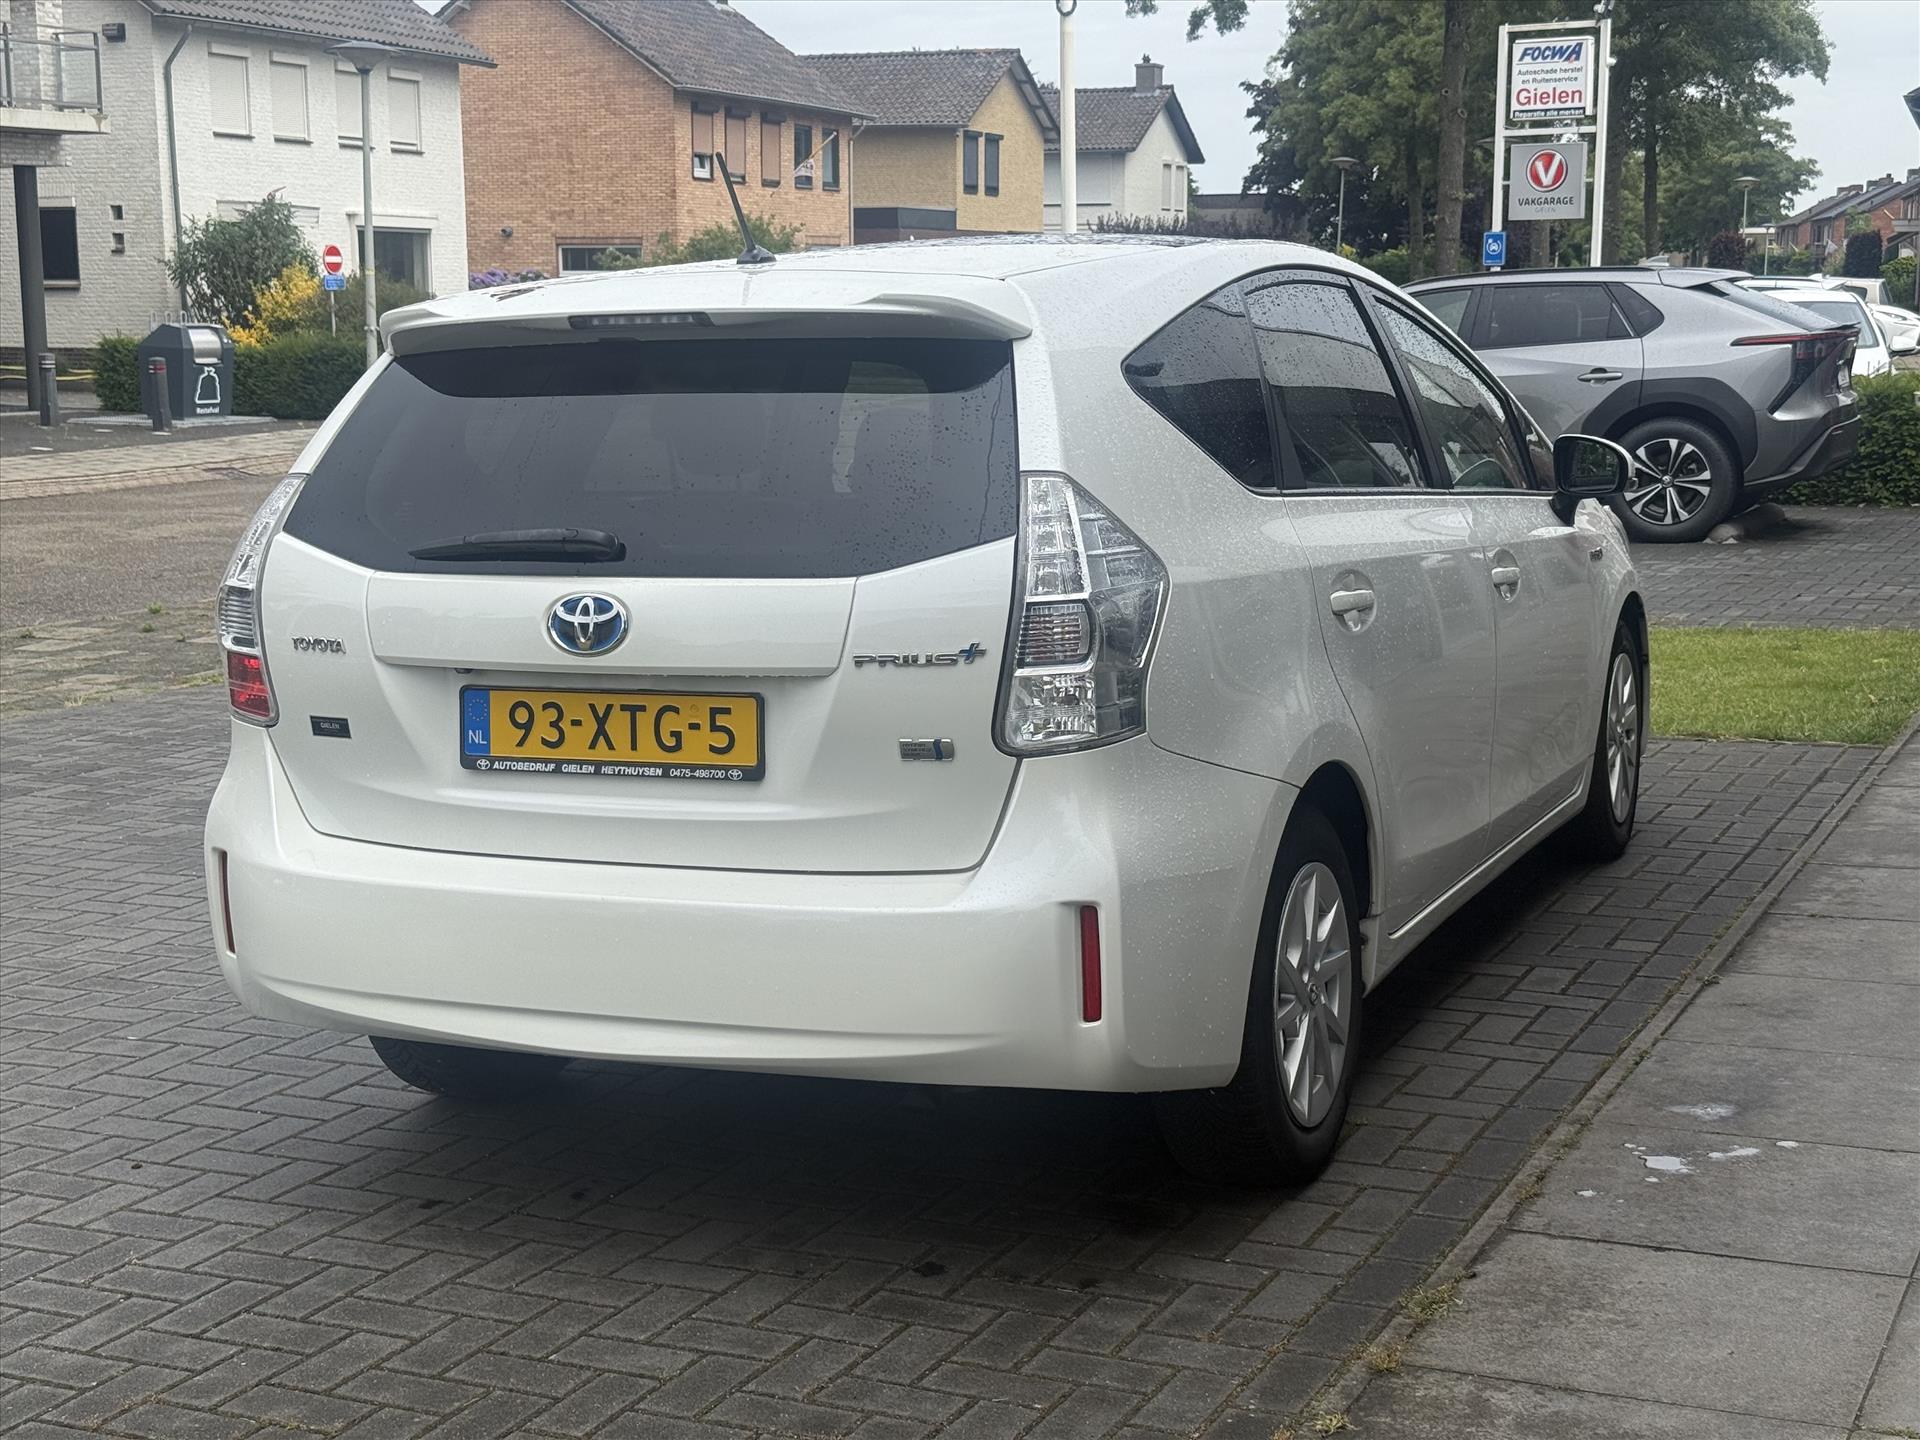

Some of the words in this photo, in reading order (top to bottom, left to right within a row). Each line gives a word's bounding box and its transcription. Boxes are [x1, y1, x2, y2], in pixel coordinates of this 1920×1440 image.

[1518, 42, 1584, 62] FOCWA
[1517, 68, 1558, 76] Autoschade
[1559, 66, 1583, 74] herstel
[1532, 76, 1578, 84] Ruitenservice
[1516, 87, 1582, 106] Gielen
[1518, 196, 1575, 206] VAKGARAGE
[292, 637, 346, 654] TOYOTA
[508, 700, 736, 755] 93-XTG-5
[468, 730, 487, 744] NL
[493, 761, 556, 772] AUTOBEDRIJF
[562, 763, 595, 774] GIELEN
[601, 765, 663, 776] HEYTHUYSEN
[669, 768, 726, 779] 0475-498700
